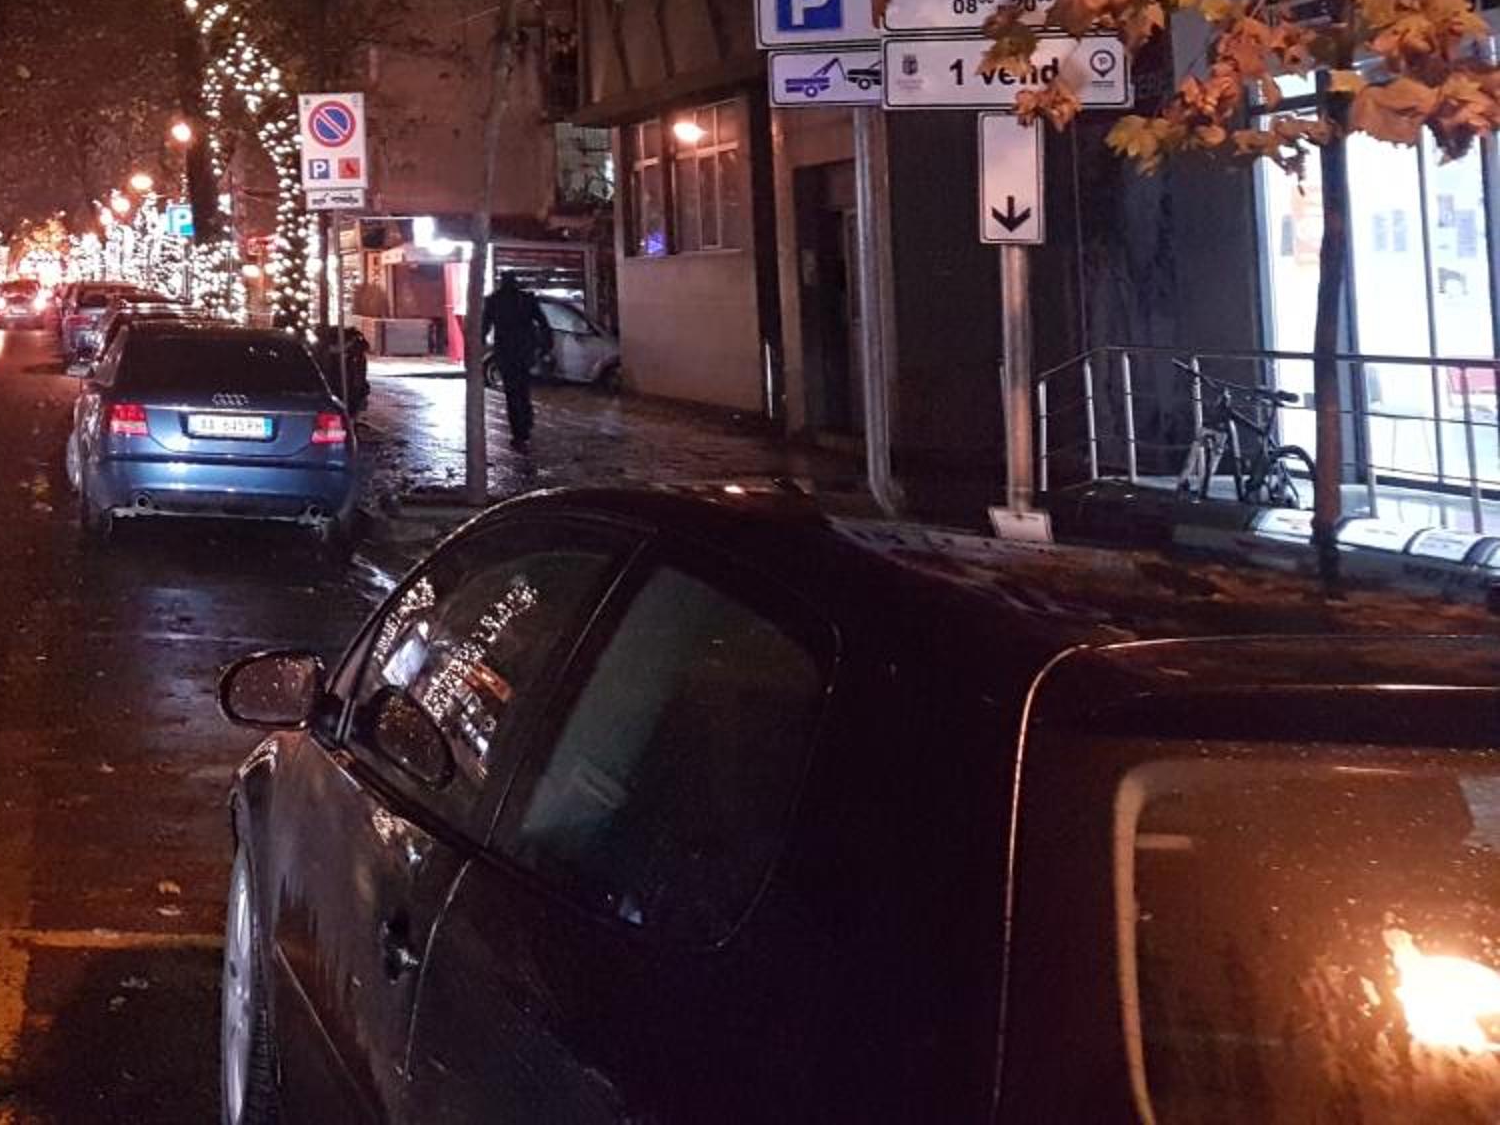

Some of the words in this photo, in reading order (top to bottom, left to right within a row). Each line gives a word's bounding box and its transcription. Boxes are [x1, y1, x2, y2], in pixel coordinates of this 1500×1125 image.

[949, 58, 964, 86] 1
[981, 57, 1060, 86] vend
[313, 160, 327, 178] P
